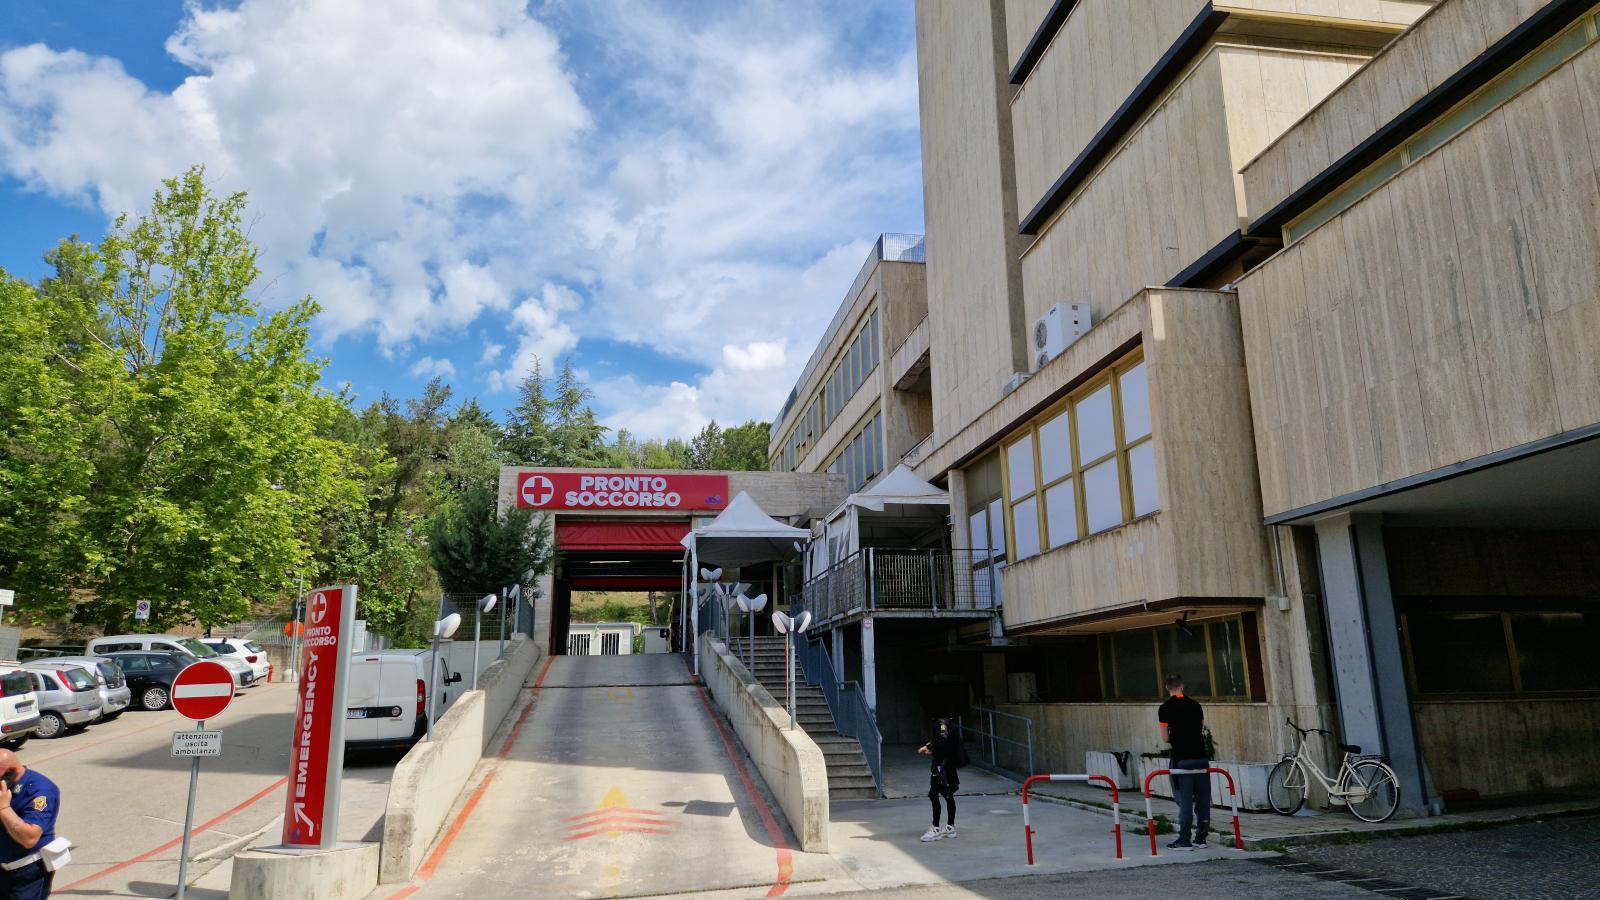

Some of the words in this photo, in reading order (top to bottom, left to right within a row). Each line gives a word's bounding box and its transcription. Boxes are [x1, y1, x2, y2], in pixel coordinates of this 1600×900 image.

[580, 476, 667, 492] PRONTO
[565, 491, 681, 507] SOCCORSO
[295, 651, 320, 797] EMERGENCY
